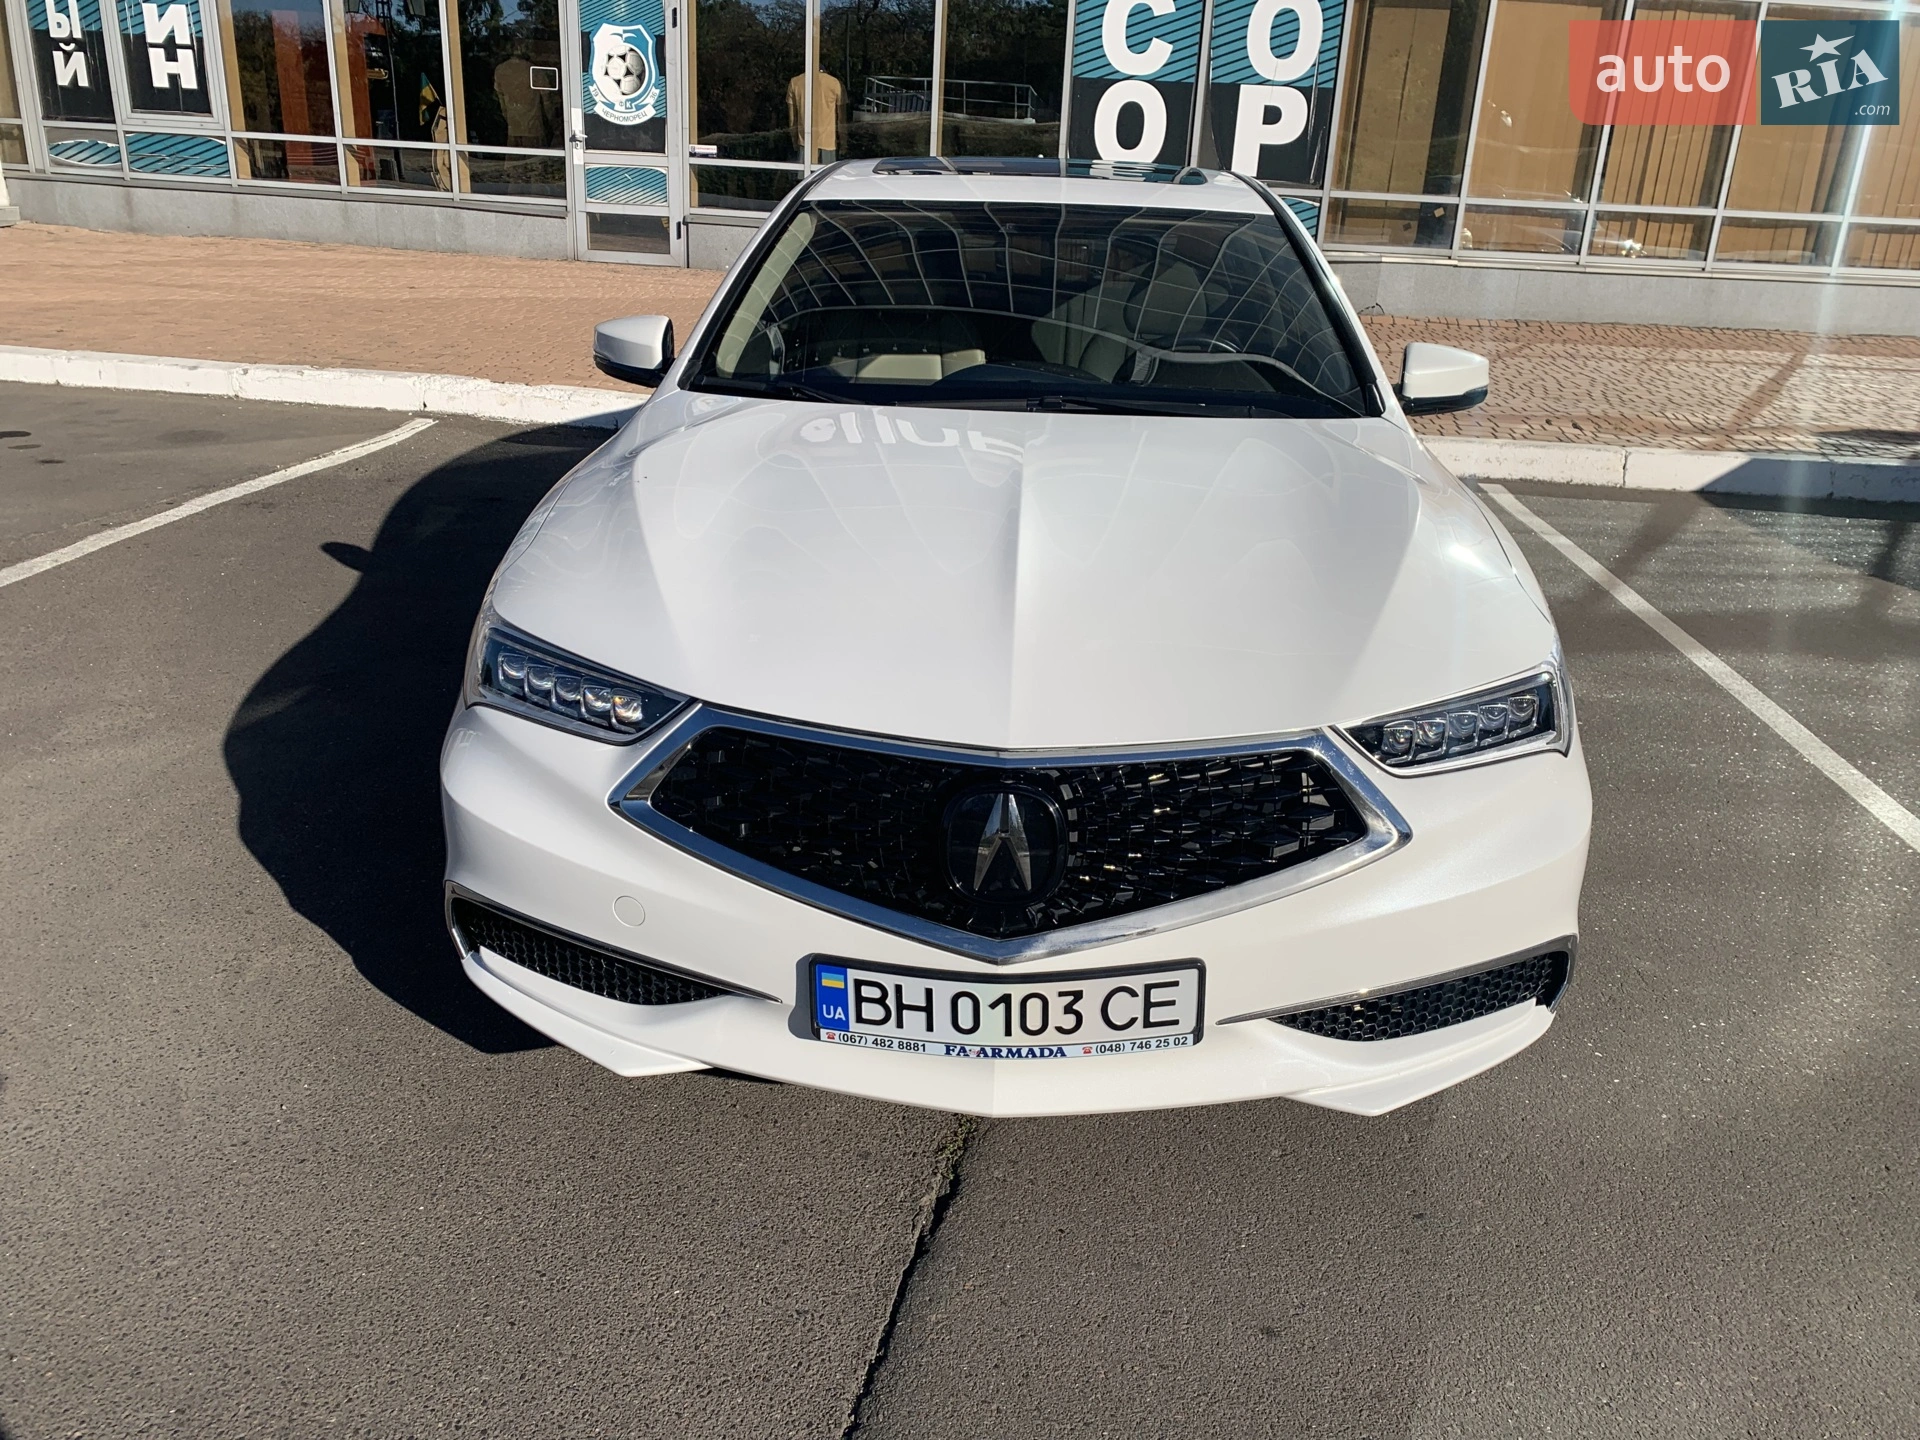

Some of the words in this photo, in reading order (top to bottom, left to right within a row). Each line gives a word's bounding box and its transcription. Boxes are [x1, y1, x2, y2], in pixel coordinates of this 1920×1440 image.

[602, 108, 648, 122] ЧЕРНОМОРЕЦ
[822, 1004, 846, 1021] UA
[853, 978, 935, 1033] BH
[950, 988, 1084, 1037] 0103
[1100, 980, 1180, 1032] CE
[838, 1033, 868, 1046] (067)
[871, 1037, 894, 1049] 482
[897, 1041, 926, 1052] 8881
[1095, 1042, 1126, 1055] (048)
[1130, 1040, 1151, 1051] 746
[1155, 1037, 1170, 1049] 25
[1173, 1036, 1188, 1047] 02
